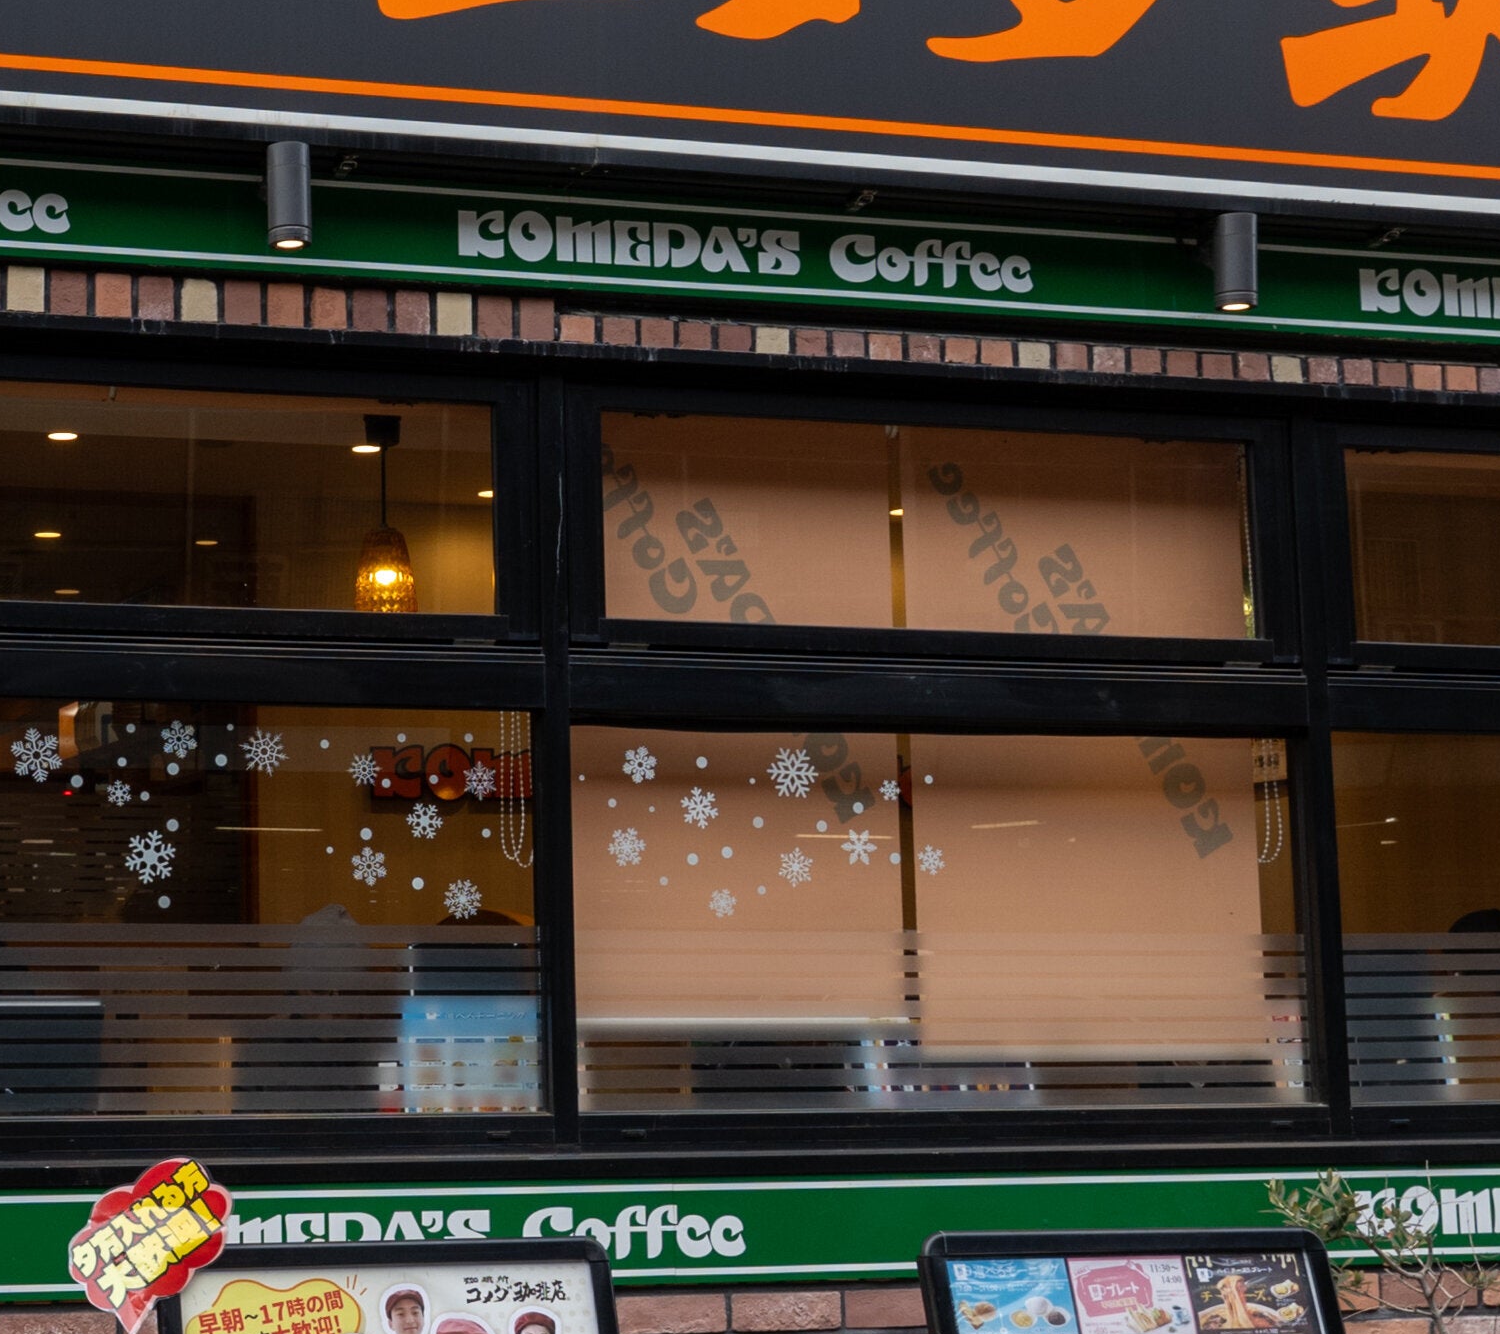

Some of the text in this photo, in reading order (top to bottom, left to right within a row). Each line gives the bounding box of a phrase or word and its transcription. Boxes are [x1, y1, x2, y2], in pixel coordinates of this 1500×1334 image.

[457, 210, 1034, 294] KOMEDA'S Coffee
[72, 1160, 210, 1277] 夕方入れる方
[96, 1197, 224, 1310] 大歓迎!
[522, 1204, 746, 1257] Coffee
[466, 1278, 567, 1304] コメダ珈琲店
